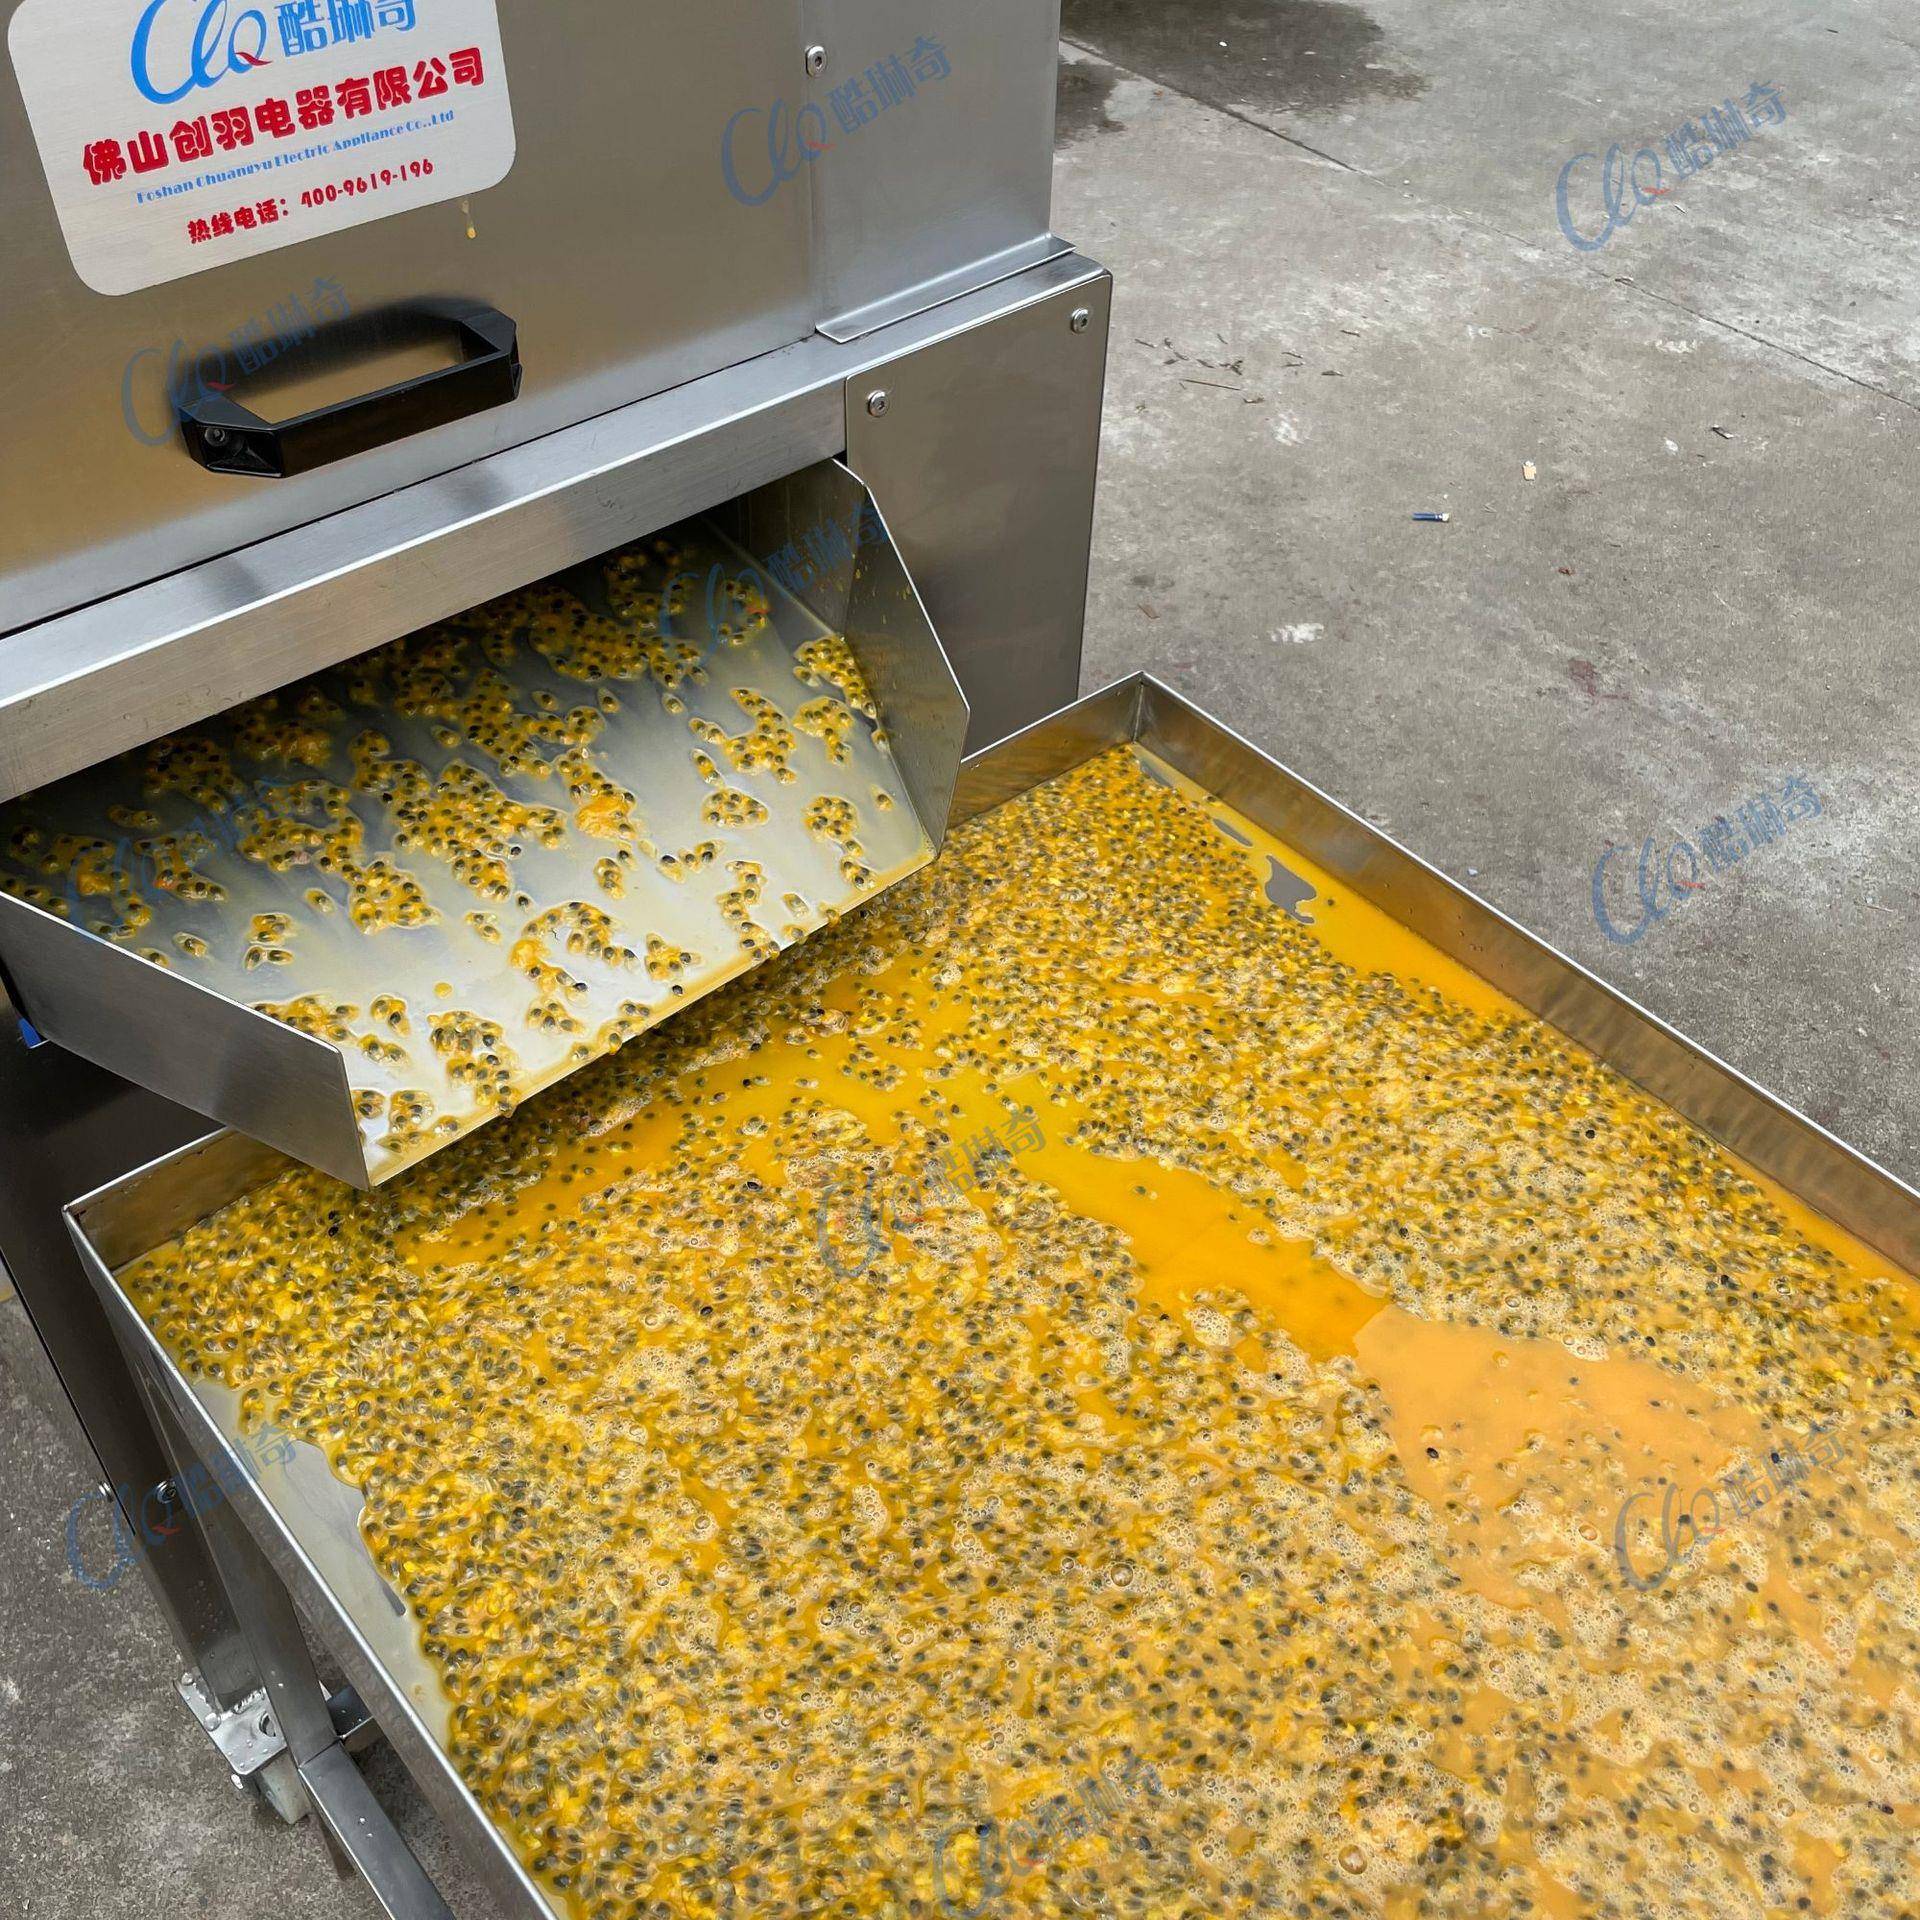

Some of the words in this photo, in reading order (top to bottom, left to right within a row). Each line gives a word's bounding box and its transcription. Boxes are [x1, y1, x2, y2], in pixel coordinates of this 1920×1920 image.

[82, 46, 485, 186] 佛山创羽电器有限公司
[137, 180, 194, 204] Foshan
[274, 144, 330, 168] Electric
[333, 126, 404, 151] Appliance
[301, 158, 434, 208] 400-9619-196
